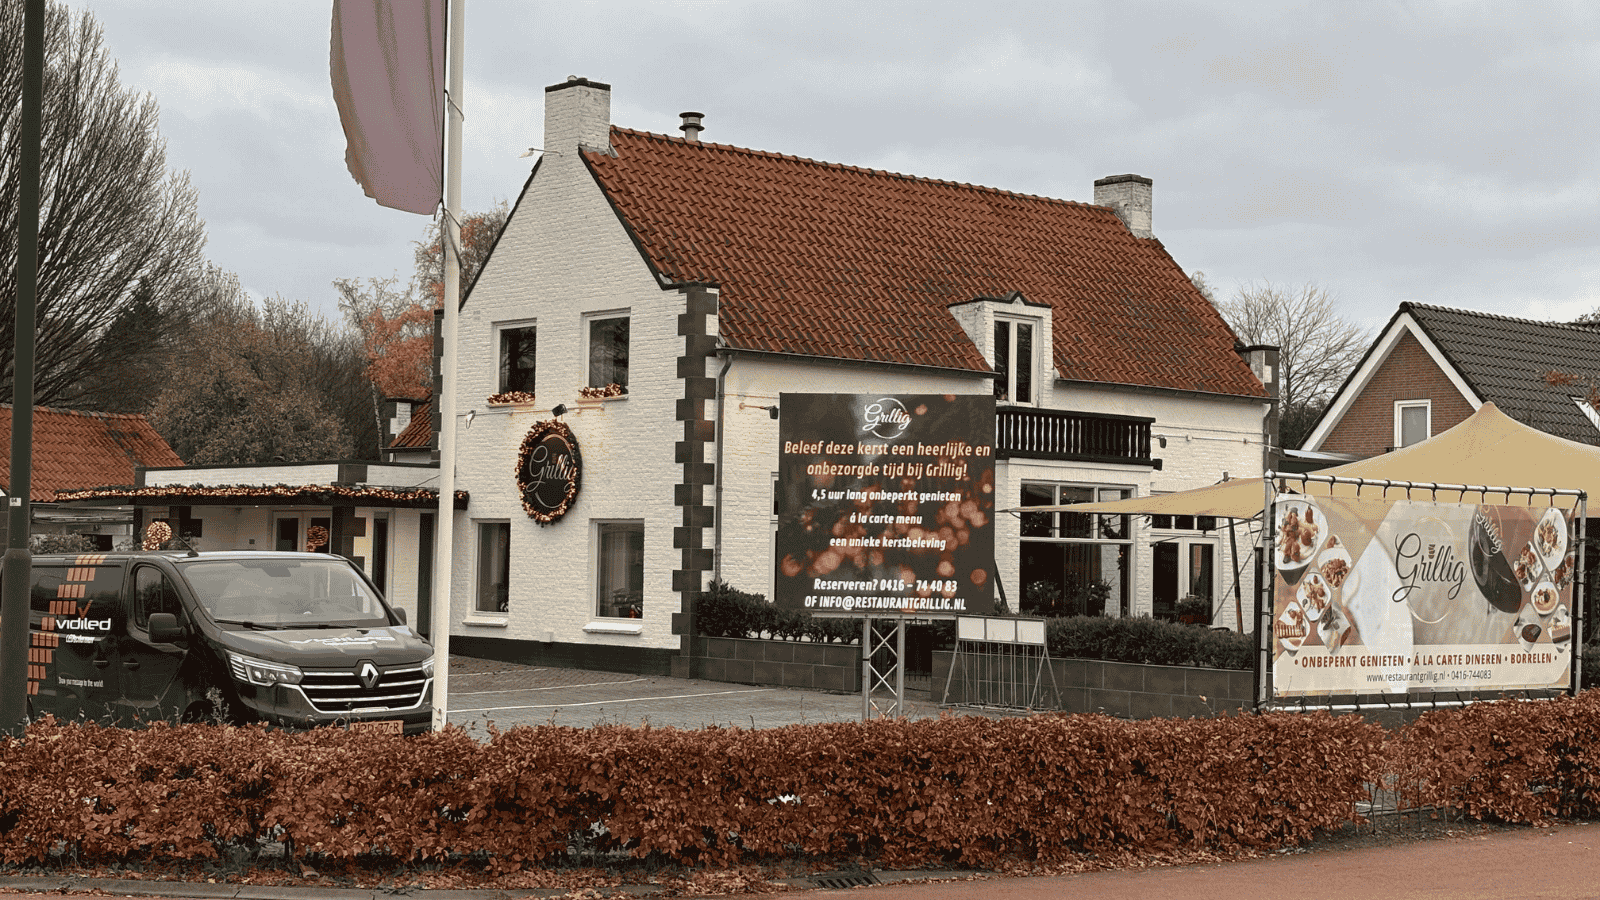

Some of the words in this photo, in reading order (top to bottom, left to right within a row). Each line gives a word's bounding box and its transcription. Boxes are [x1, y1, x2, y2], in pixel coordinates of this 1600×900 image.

[862, 404, 912, 431] Grillig
[785, 441, 824, 454] Beleef
[826, 442, 854, 455] deze
[858, 442, 888, 455] kerst
[892, 445, 914, 455] een
[917, 442, 972, 459] heerlijke
[975, 446, 991, 456] en
[807, 462, 880, 479] onbezorgde
[883, 463, 903, 479] tijd
[907, 464, 923, 479] bij
[926, 464, 967, 480] Grillig!
[812, 489, 826, 501] 4,5
[828, 492, 845, 500] uur
[846, 490, 867, 503] lang
[869, 490, 917, 503] onbeperkt
[920, 492, 961, 504] genieten
[850, 512, 856, 523] á
[858, 513, 867, 523] la
[869, 514, 894, 524] carte
[896, 516, 922, 524] menu
[830, 538, 847, 547] een
[849, 537, 880, 548] unieke
[883, 537, 946, 550] kerstbeleving
[1392, 533, 1468, 603] Grillig
[814, 578, 878, 591] Reserveren?
[880, 580, 905, 592] 0416
[916, 580, 928, 592] 74
[930, 580, 942, 592] 40
[945, 580, 957, 592] 83
[804, 596, 818, 607] OF
[819, 596, 967, 611] INFO@RESTAURANTGRILLIG.NL
[56, 617, 112, 631] vidiled
[1302, 656, 1357, 668] ONBEPERKT
[1360, 655, 1404, 667] GENIETEN
[1423, 655, 1434, 666] LA
[1436, 655, 1463, 666] CARTE
[1466, 654, 1502, 665] DINEREN
[1511, 653, 1552, 664] BORRELEN
[1367, 671, 1445, 683] www.restaurantgrillig.nl
[1451, 670, 1492, 680] 0416-744083
